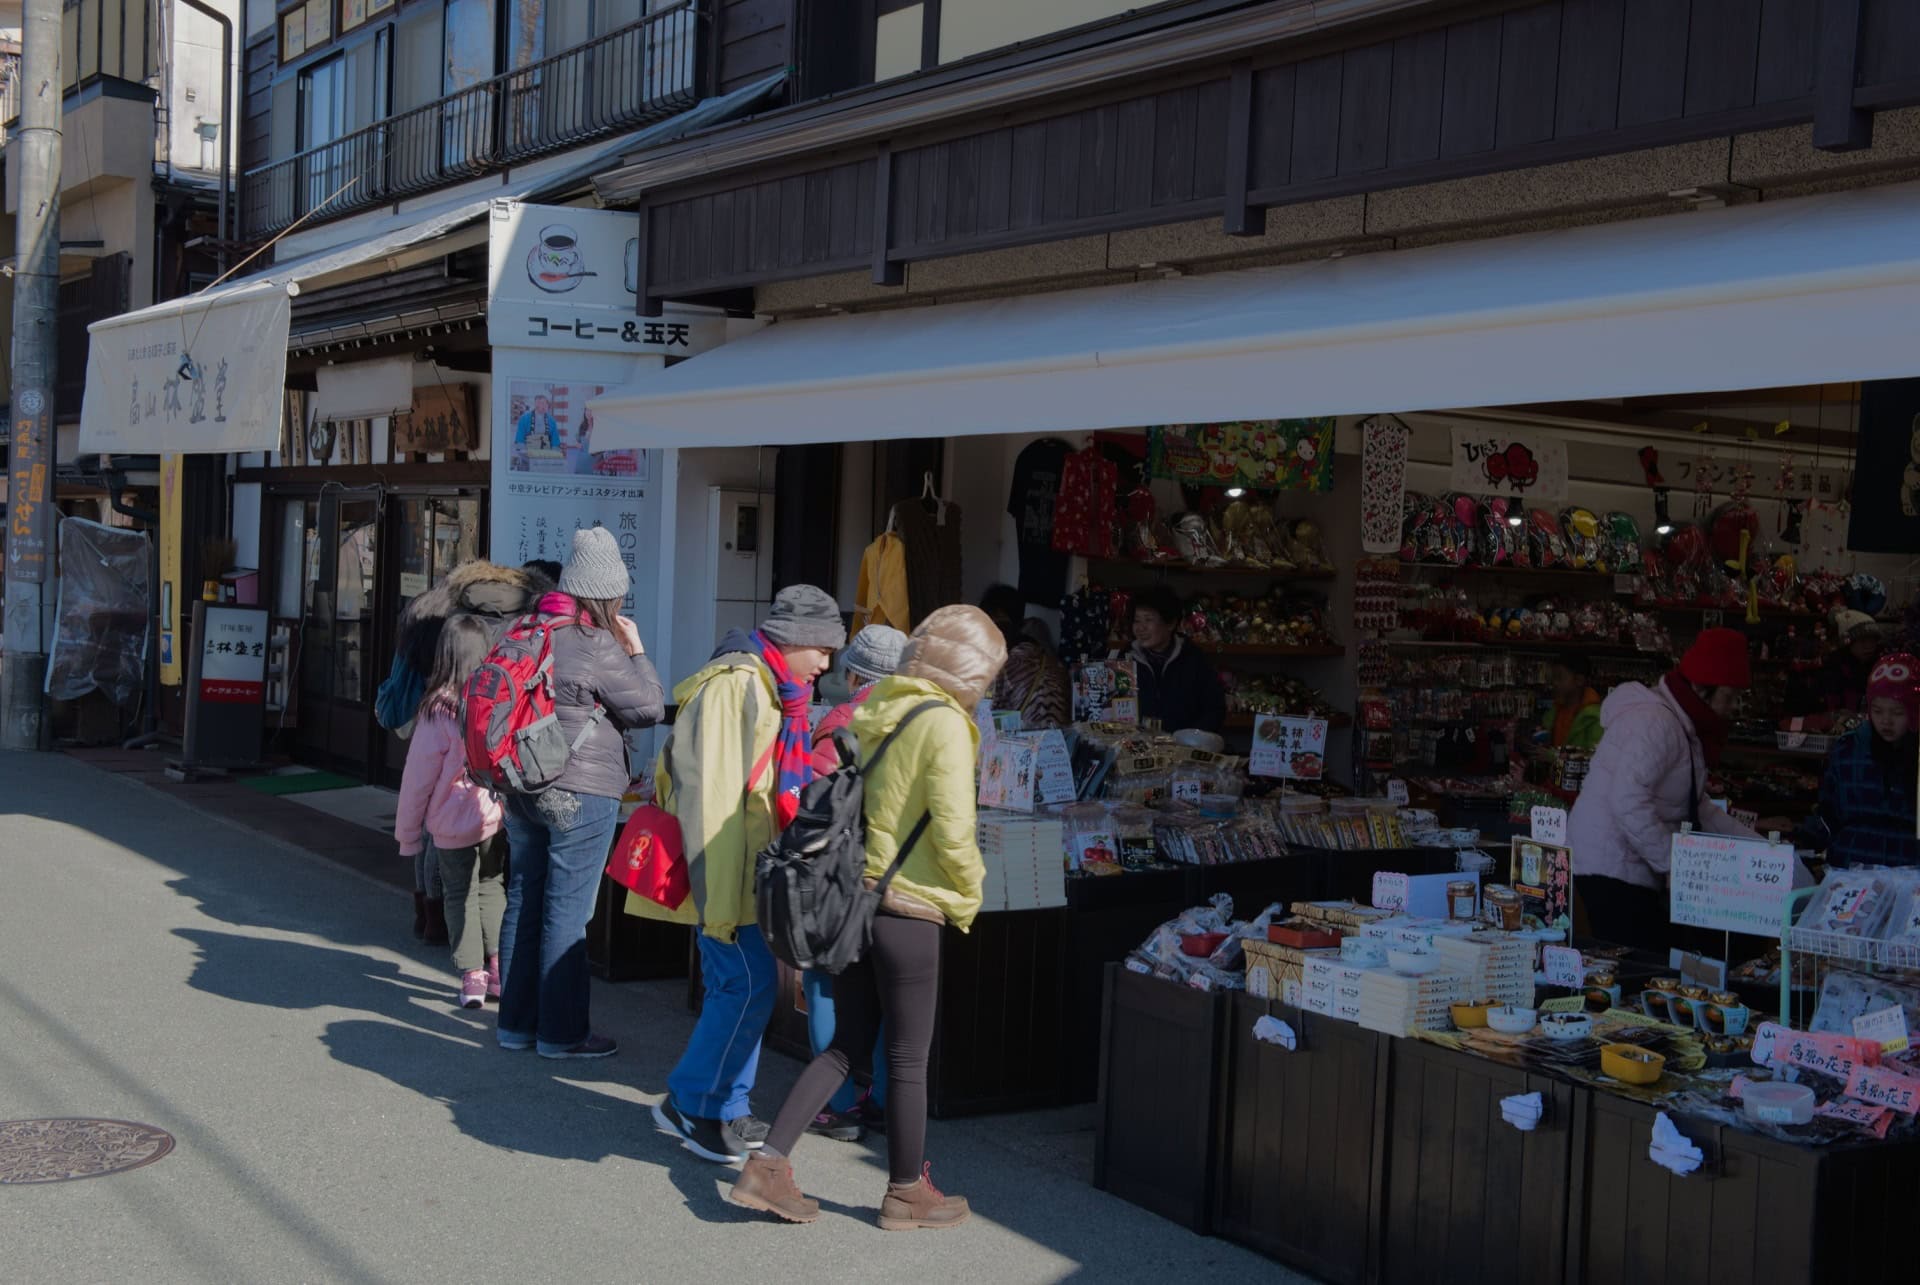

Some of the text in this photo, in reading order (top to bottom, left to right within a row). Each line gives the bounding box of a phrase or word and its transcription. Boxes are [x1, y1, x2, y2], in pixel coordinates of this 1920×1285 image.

[528, 317, 689, 347] コーヒー&玉天
